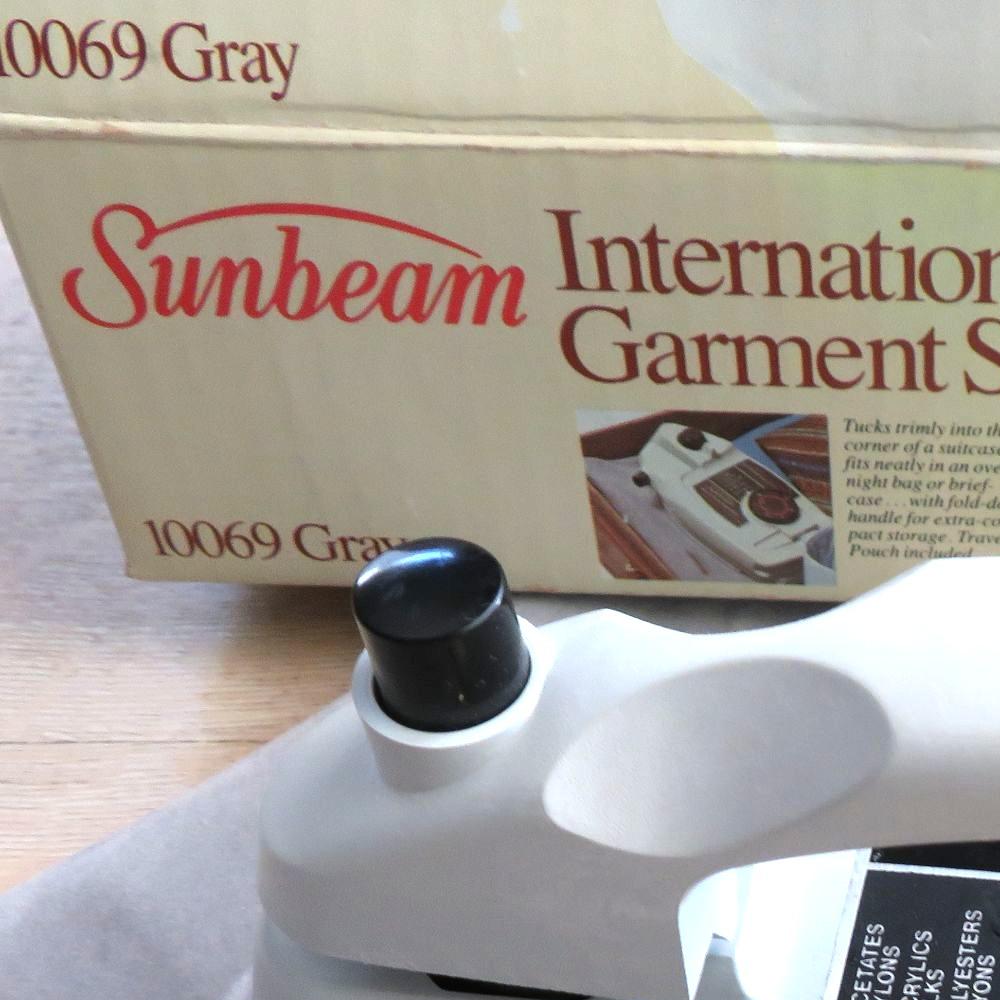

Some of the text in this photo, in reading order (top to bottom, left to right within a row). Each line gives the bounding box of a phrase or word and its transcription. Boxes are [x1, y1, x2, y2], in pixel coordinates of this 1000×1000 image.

[161, 22, 299, 101] Gray
[62, 203, 528, 329] Sunbeam
[559, 305, 950, 393] Garment
[843, 418, 891, 433] Tucks
[895, 421, 944, 437] trimly
[950, 421, 983, 437] into
[843, 441, 899, 452] corner
[903, 440, 921, 455] of
[923, 443, 934, 454] a
[843, 456, 870, 472] fits
[874, 457, 924, 474] neatly
[928, 459, 944, 473] in
[948, 461, 969, 473] an
[846, 475, 888, 490] night
[892, 475, 922, 493] bag
[925, 480, 944, 490] or
[847, 510, 901, 525] handle
[904, 511, 929, 528] for
[143, 519, 282, 560] 10069
[847, 528, 882, 543] pact
[849, 543, 900, 558] Pouch
